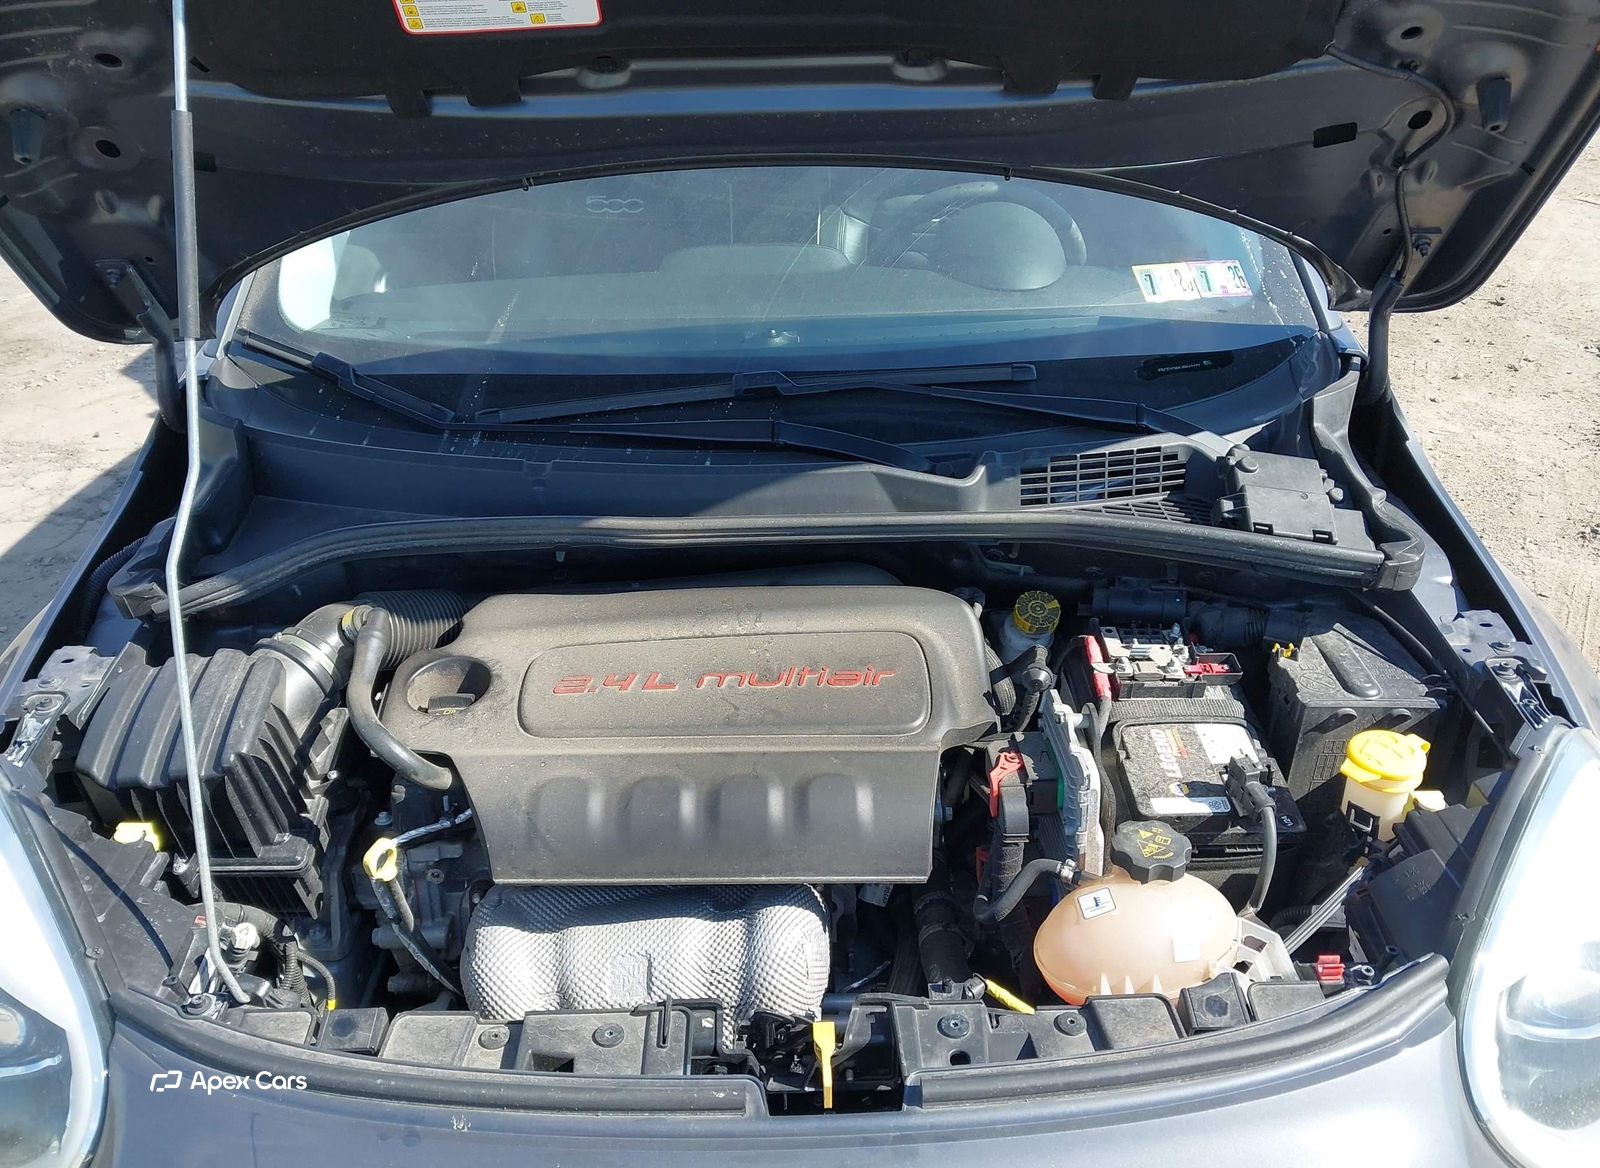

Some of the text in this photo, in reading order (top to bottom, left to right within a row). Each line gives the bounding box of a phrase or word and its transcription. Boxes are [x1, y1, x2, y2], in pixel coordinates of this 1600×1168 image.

[1144, 273, 1157, 296] 7
[1200, 270, 1212, 292] 7
[696, 665, 895, 690] multiair
[1150, 728, 1184, 779] LEGEND
